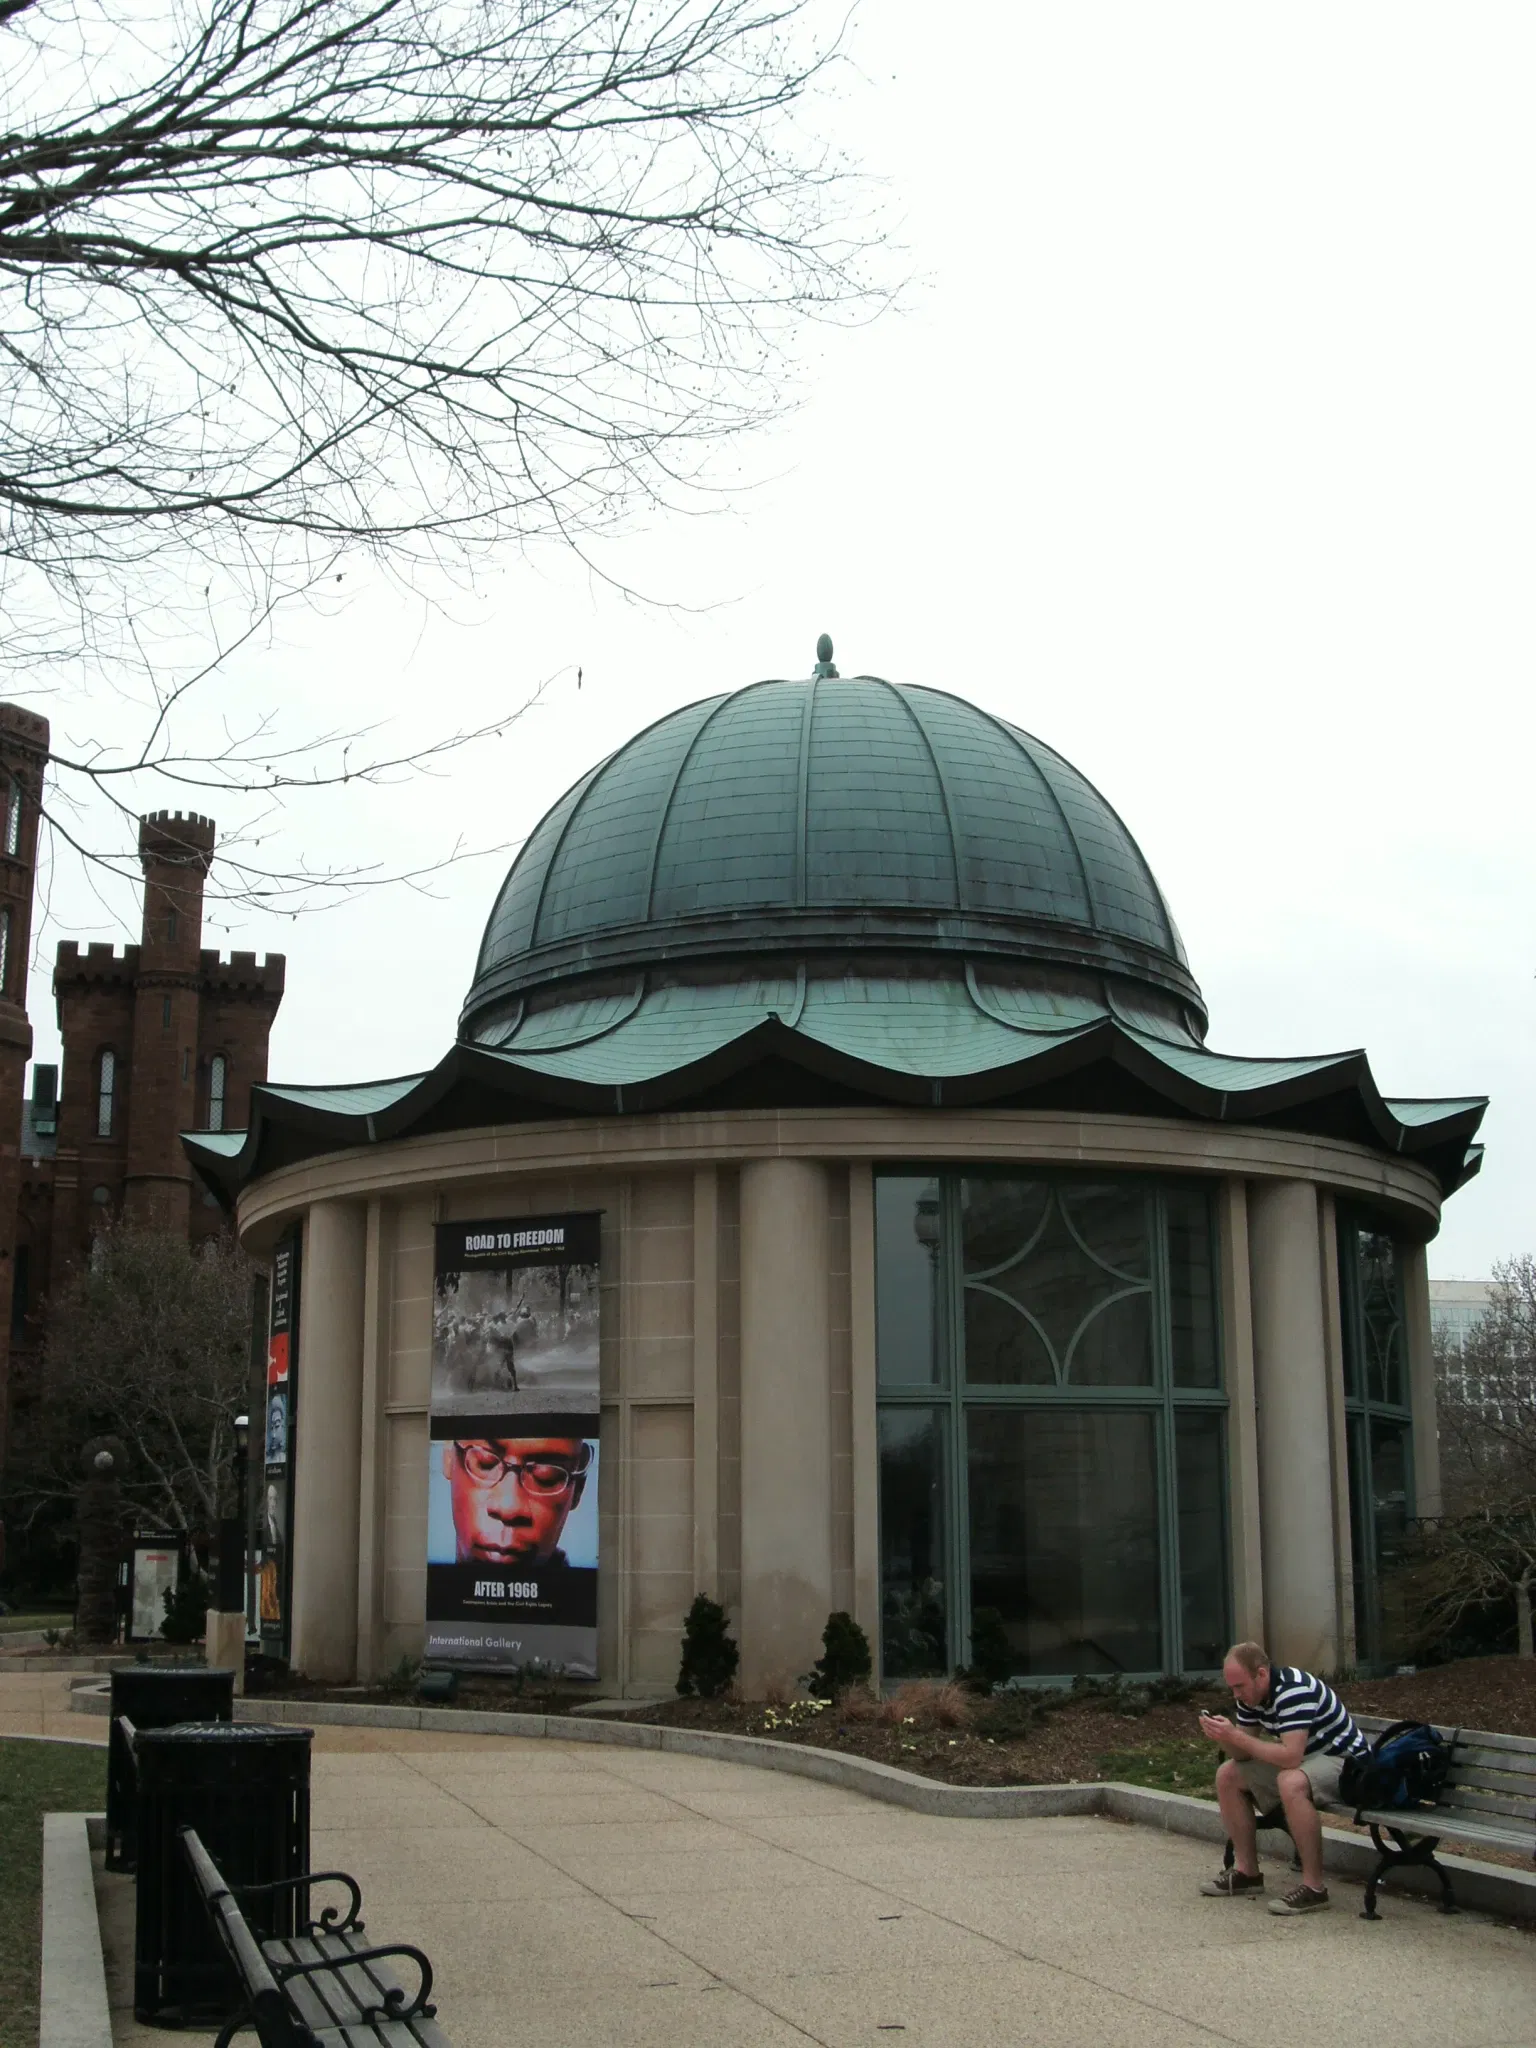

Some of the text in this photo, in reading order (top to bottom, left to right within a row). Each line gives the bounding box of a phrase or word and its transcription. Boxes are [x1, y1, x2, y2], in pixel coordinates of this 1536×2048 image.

[465, 1228, 564, 1251] ROAD TO FREEDOM
[474, 1581, 538, 1598] AFTER 1968
[429, 1635, 522, 1651] International Gallery
